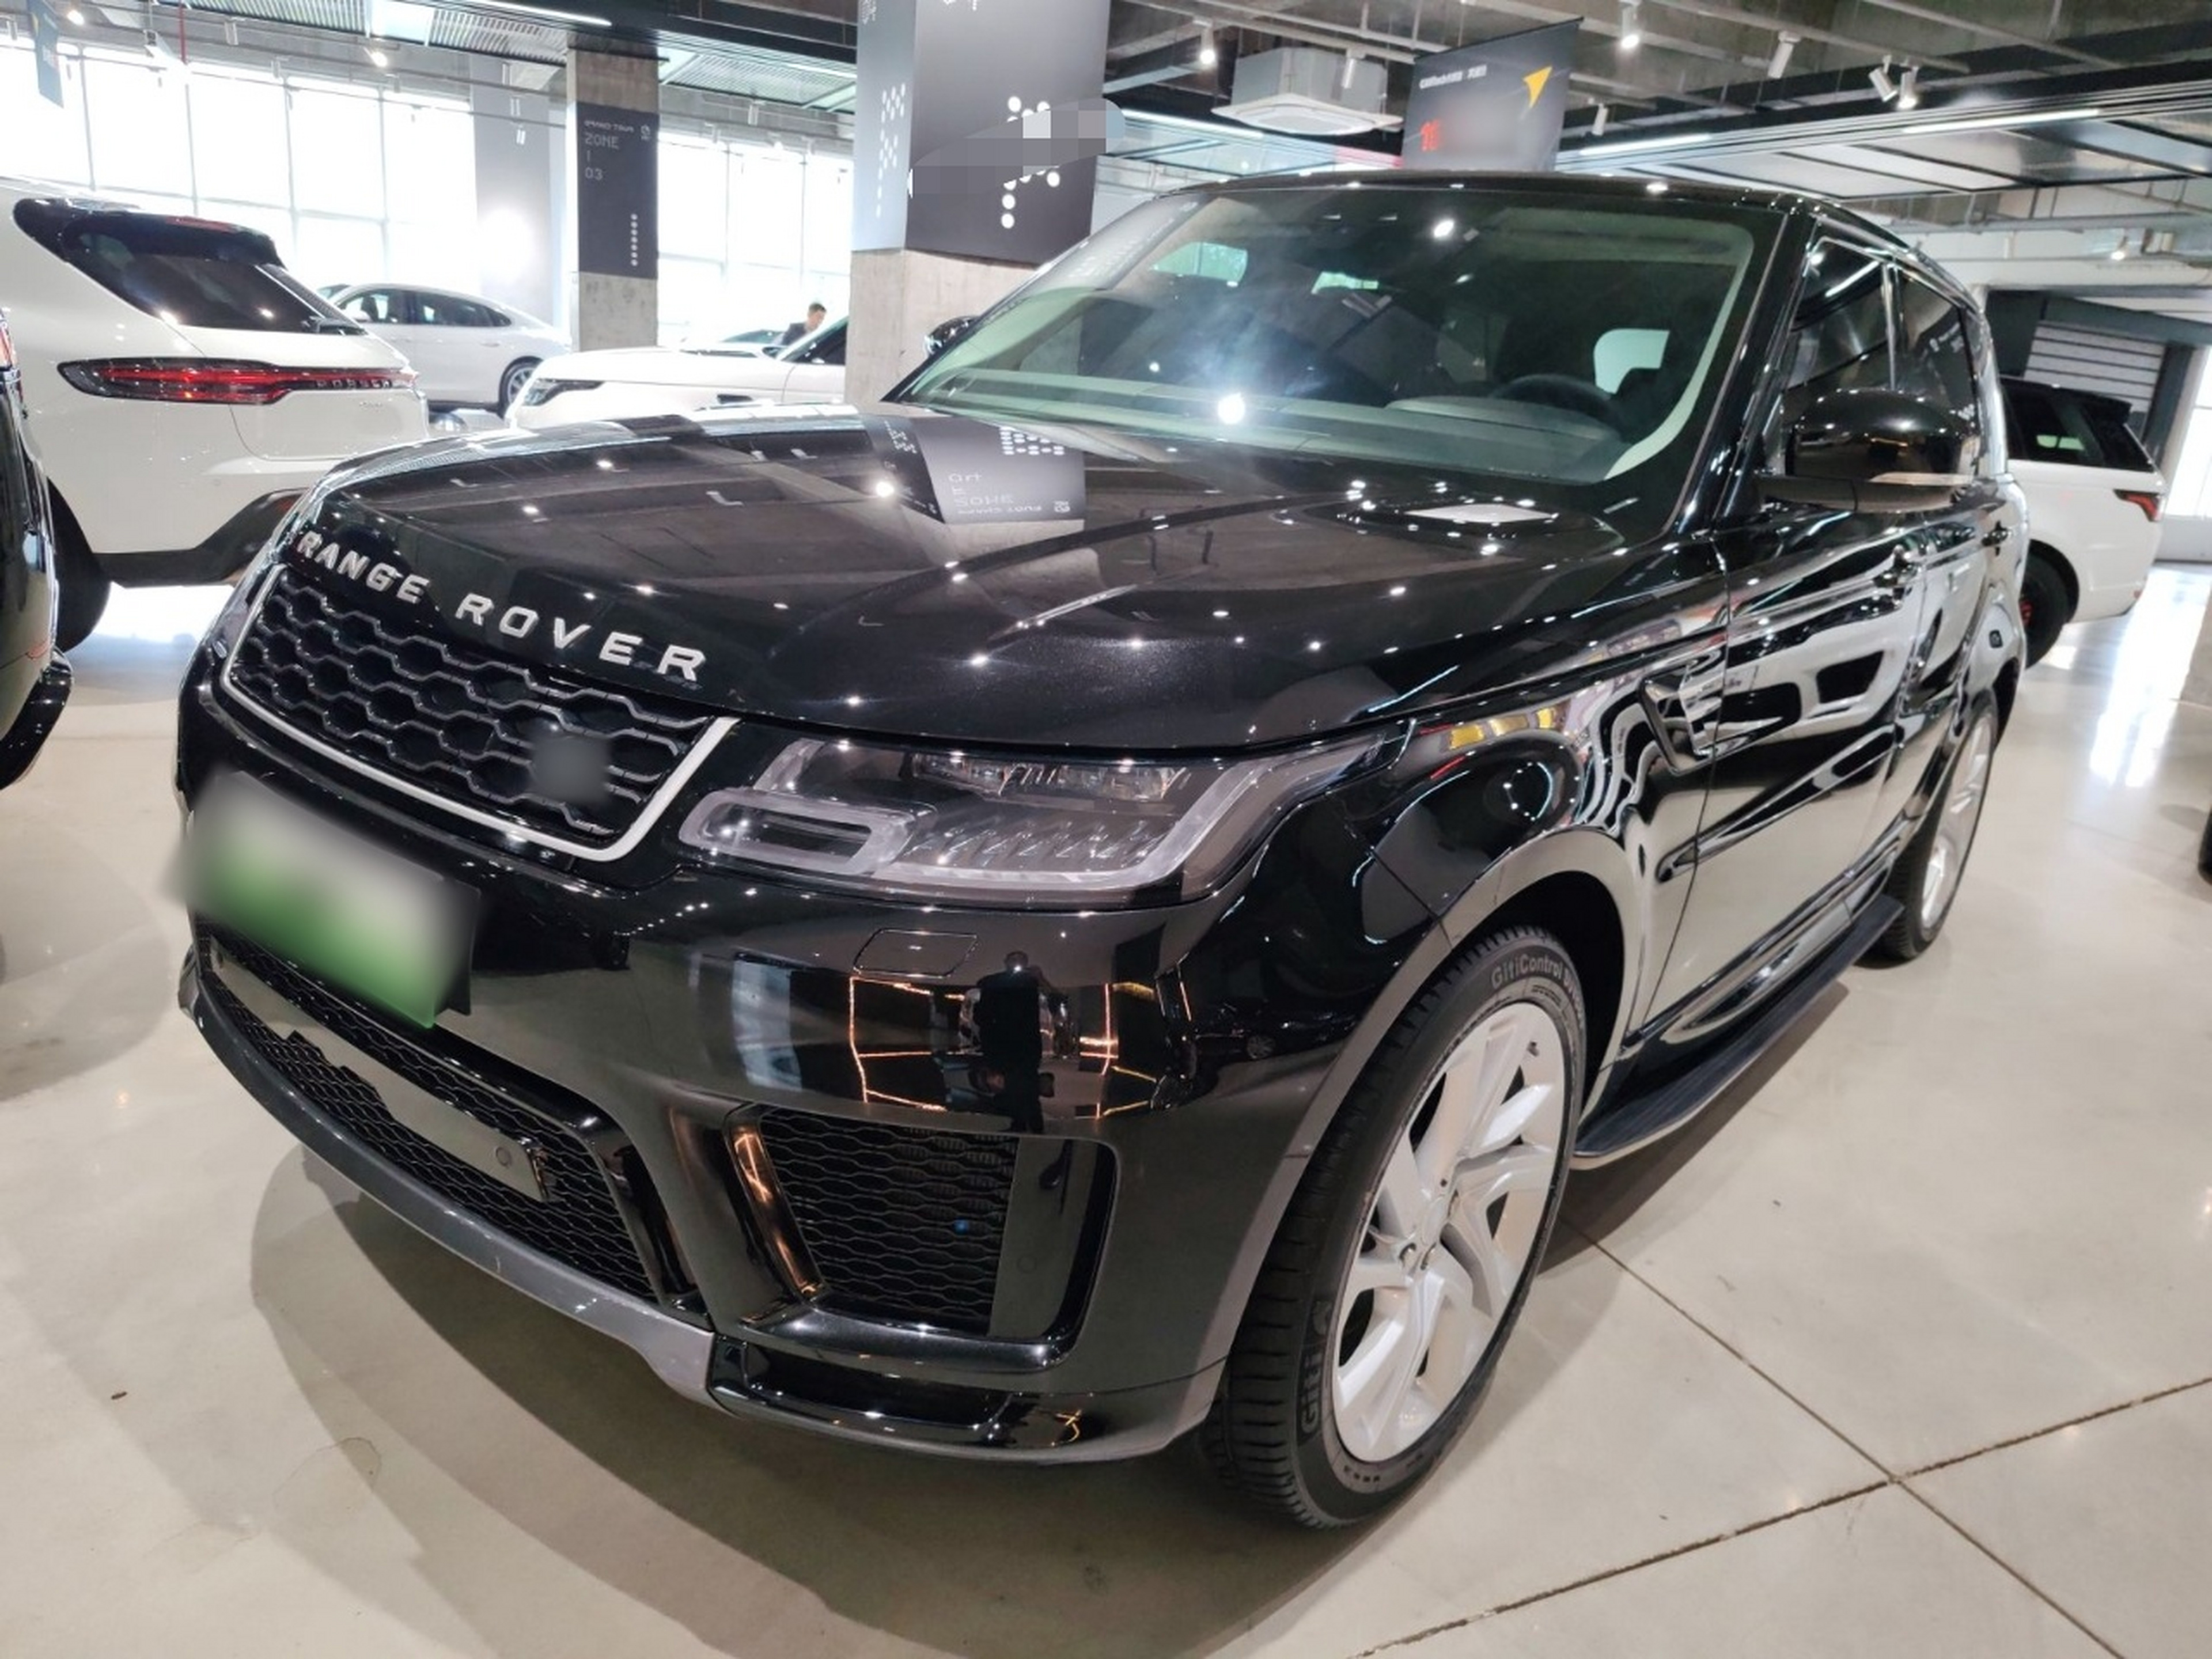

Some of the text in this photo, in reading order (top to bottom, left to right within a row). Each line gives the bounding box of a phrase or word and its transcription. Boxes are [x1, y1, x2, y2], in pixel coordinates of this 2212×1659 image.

[585, 132, 619, 150] ZONE
[585, 166, 603, 180] 03
[297, 530, 707, 682] RANGE ROVER
